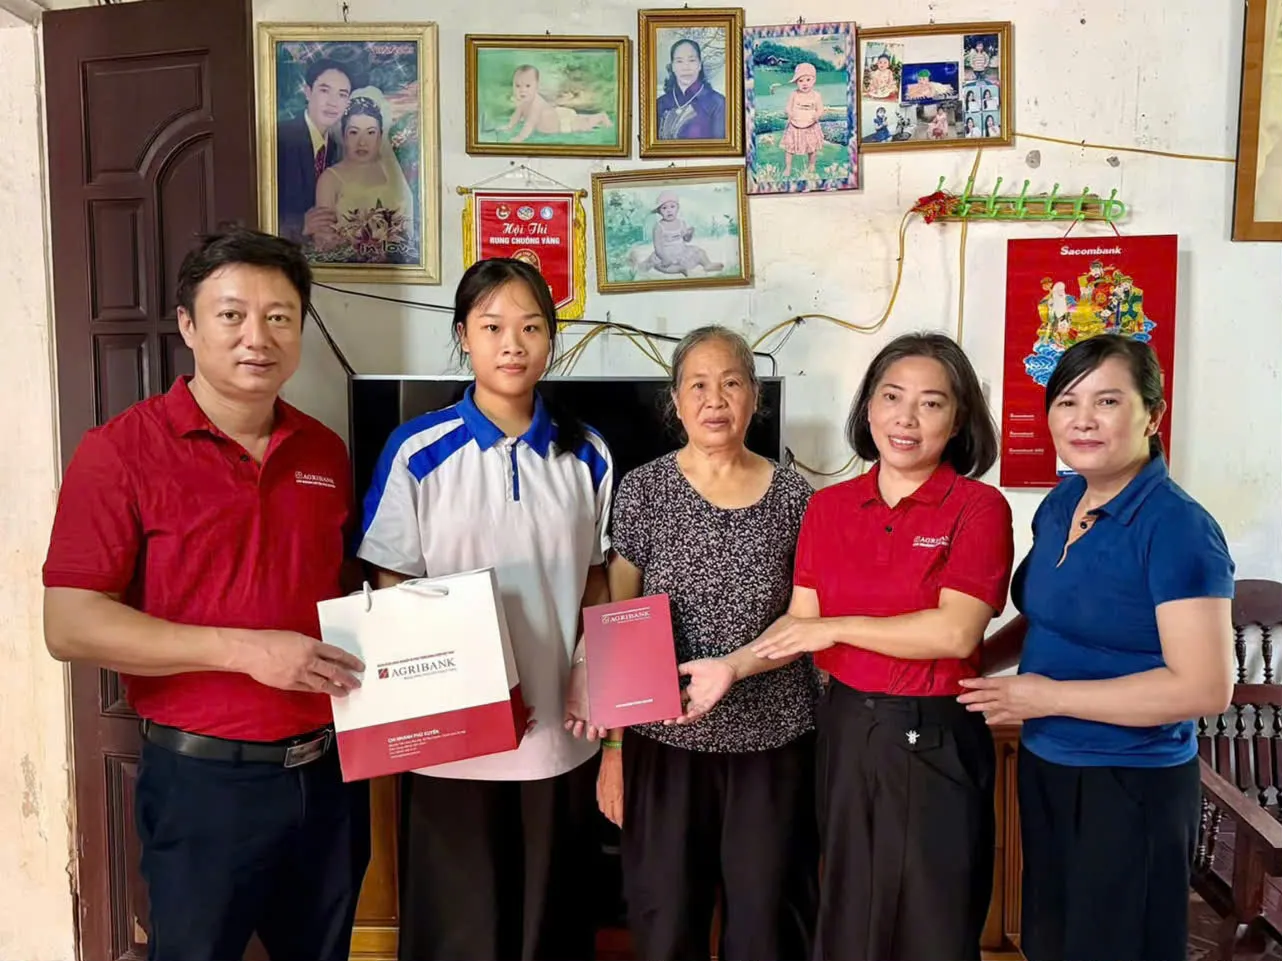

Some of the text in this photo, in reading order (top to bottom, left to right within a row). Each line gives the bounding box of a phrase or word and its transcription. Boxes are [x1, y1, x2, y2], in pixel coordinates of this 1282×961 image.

[527, 222, 549, 235] Thi
[489, 236, 510, 245] RUNG
[1060, 245, 1122, 256] Sacombank
[391, 657, 456, 678] AGRIBANK
